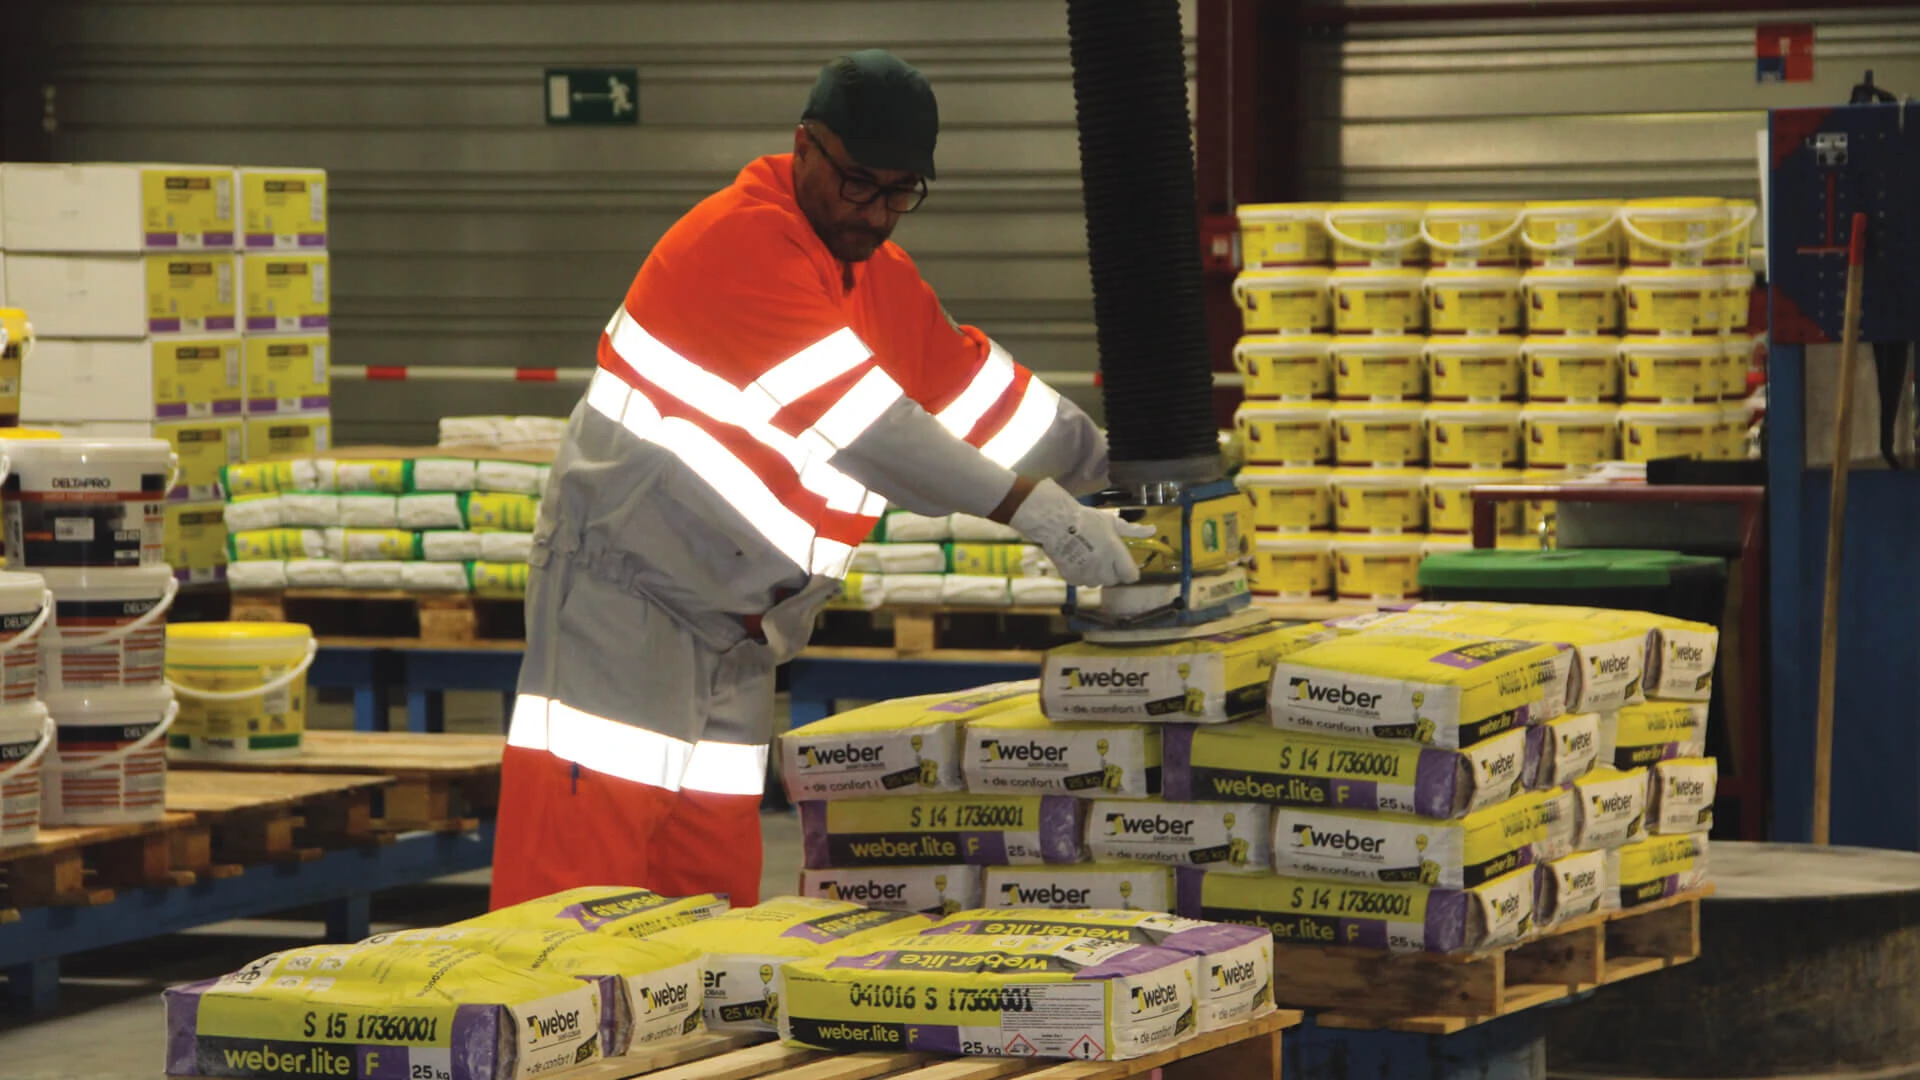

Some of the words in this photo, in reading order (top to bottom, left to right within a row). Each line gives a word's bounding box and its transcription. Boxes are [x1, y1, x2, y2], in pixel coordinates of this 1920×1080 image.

[1599, 653, 1630, 673] weber
[1078, 667, 1149, 687] weber
[1306, 684, 1382, 709] weber
[1297, 715, 1314, 726] de
[815, 743, 884, 765] weber
[998, 740, 1068, 760] weber
[1279, 747, 1292, 770] S
[1299, 748, 1319, 771] 14
[1327, 750, 1400, 777] 17360001
[992, 776, 1006, 786] de
[1213, 776, 1325, 803] weber.lite
[1336, 786, 1351, 803] F
[1379, 797, 1398, 809] 25
[1401, 801, 1414, 814] kg
[1601, 792, 1632, 813] weber
[909, 806, 921, 827] S
[930, 806, 947, 827] 14
[955, 806, 1024, 827] 17360001
[1123, 814, 1194, 834] weber
[850, 836, 956, 858] weber.lite
[967, 837, 980, 856] F
[1007, 845, 1025, 857] 25
[1311, 829, 1385, 853] weber
[838, 880, 906, 899] weber
[1018, 882, 1091, 904] weber
[1291, 887, 1303, 909] S
[1311, 888, 1331, 911] 14
[1338, 890, 1411, 917] 17360001
[985, 922, 1130, 941] weber.lite
[1346, 924, 1359, 941] F
[1389, 936, 1408, 947] 25
[864, 954, 886, 967] F
[899, 953, 1049, 971] weber.lite
[1223, 960, 1255, 987] weber
[651, 981, 688, 1009] weber
[850, 982, 916, 1009] 041016
[924, 987, 938, 1011] S
[948, 987, 1034, 1013] 17360001
[1144, 982, 1177, 1009] weber
[537, 1008, 580, 1038] weber
[723, 1007, 742, 1021] 25
[303, 1011, 317, 1038] S
[326, 1012, 348, 1039] 15
[356, 1013, 438, 1042] 17360001
[818, 1023, 900, 1043] weber.lite
[908, 1028, 920, 1044] F
[962, 1041, 983, 1055] 25
[223, 1045, 351, 1076] weber.lite
[365, 1052, 380, 1076] F
[412, 1064, 433, 1079] 25
[436, 1069, 450, 1080] kg
